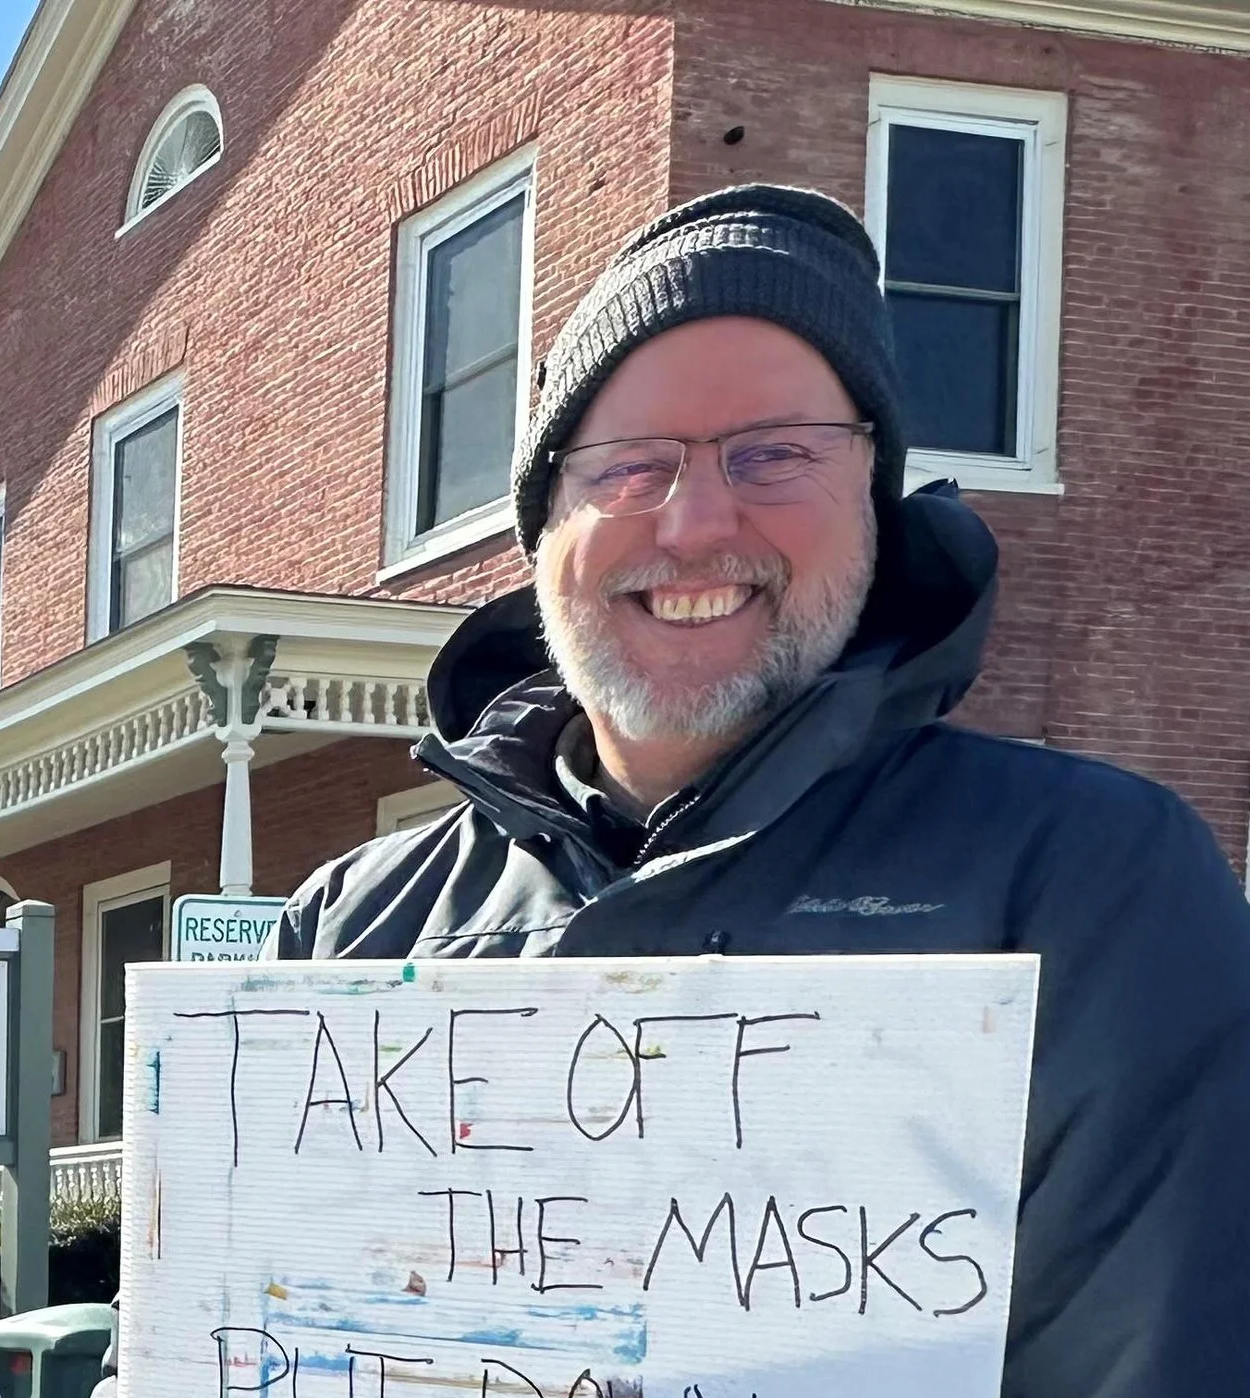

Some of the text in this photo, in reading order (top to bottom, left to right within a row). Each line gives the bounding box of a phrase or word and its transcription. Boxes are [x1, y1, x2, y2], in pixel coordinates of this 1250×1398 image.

[173, 1008, 821, 1167] TAKE OFF
[417, 1188, 989, 1317] THE MASKS
